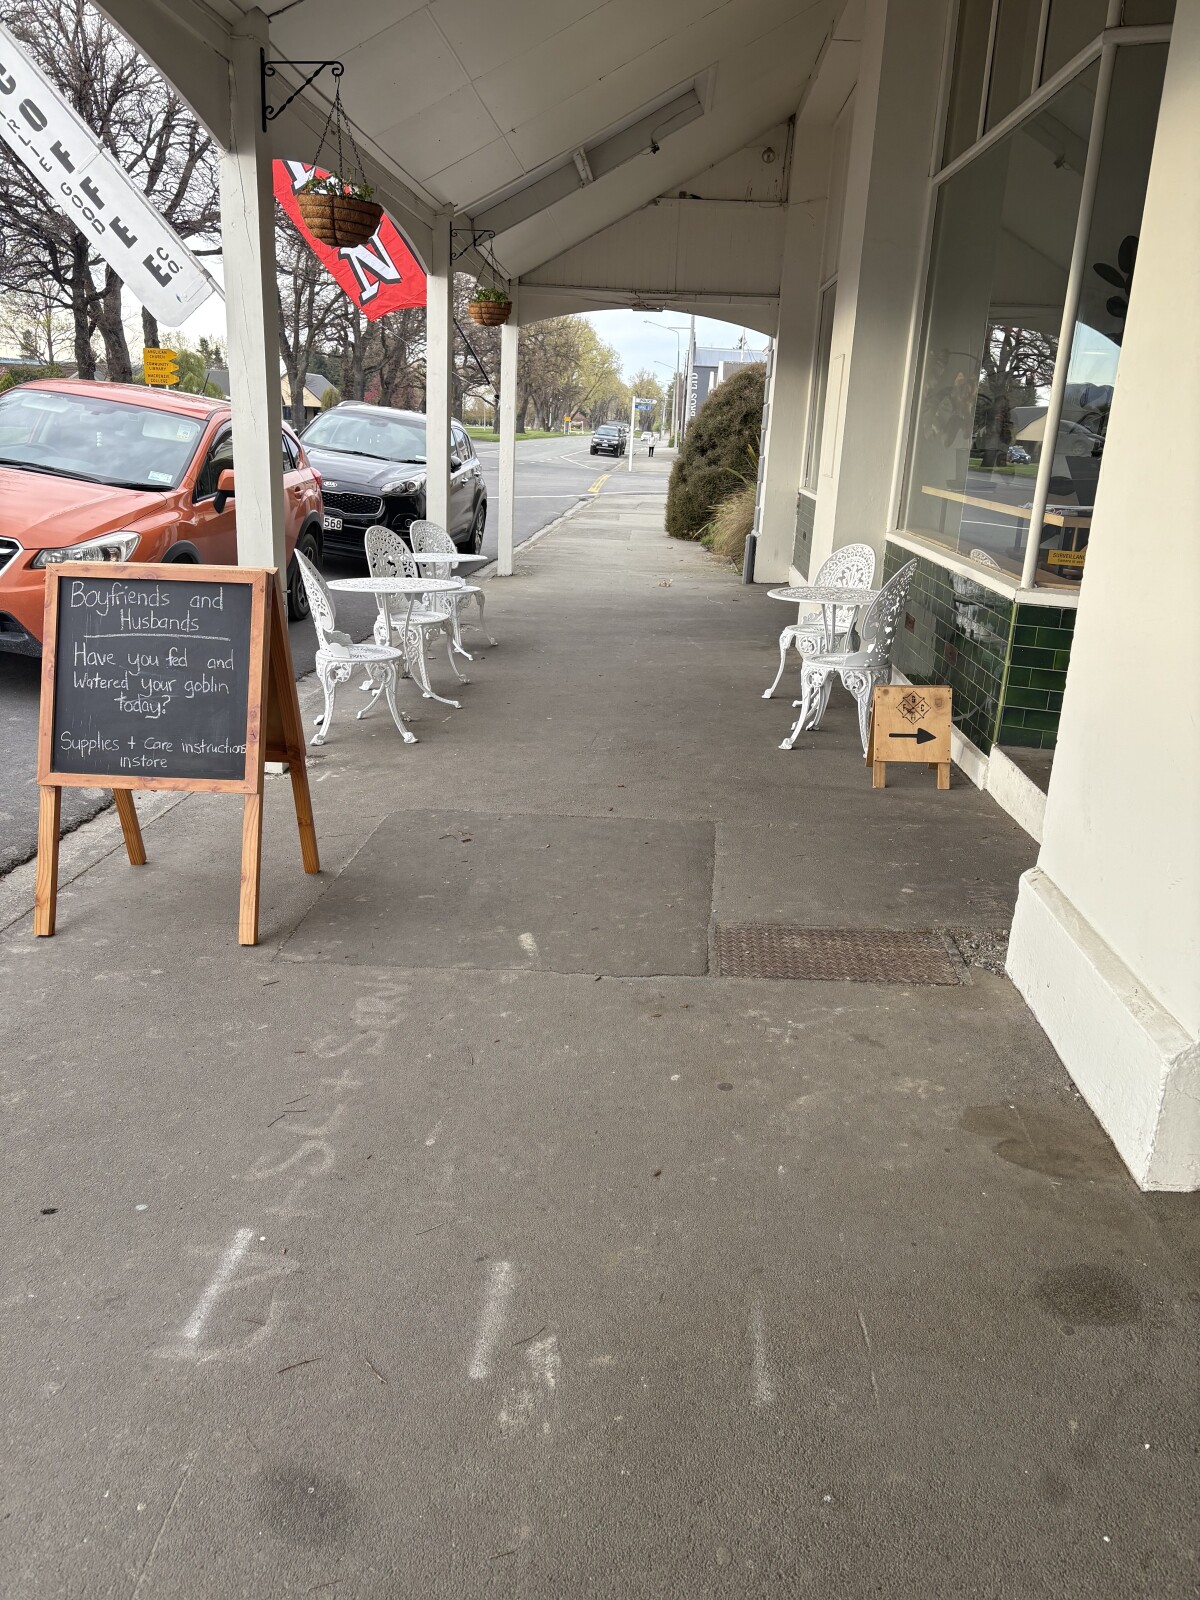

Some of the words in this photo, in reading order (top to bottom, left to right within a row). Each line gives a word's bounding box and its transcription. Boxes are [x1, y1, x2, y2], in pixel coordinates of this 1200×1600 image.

[0, 111, 53, 173] IRLIE
[60, 182, 106, 235] GOOD
[0, 62, 173, 288] COFFEE
[324, 517, 341, 529] 568
[1053, 552, 1085, 560] SURVEILLANC
[70, 580, 170, 616] Boyfriends
[189, 586, 224, 612] and
[120, 607, 200, 632] Husbands
[73, 641, 117, 667] Have
[127, 653, 160, 676] you
[165, 646, 188, 667] fed
[207, 649, 234, 671] and
[73, 670, 129, 690] Watered
[140, 678, 177, 698] your
[184, 672, 229, 699] goblin
[113, 690, 171, 719] today?
[60, 730, 120, 758] Supplies
[127, 735, 136, 750] +
[143, 737, 174, 752] Care
[180, 737, 247, 755] instructions
[120, 754, 168, 769] instore
